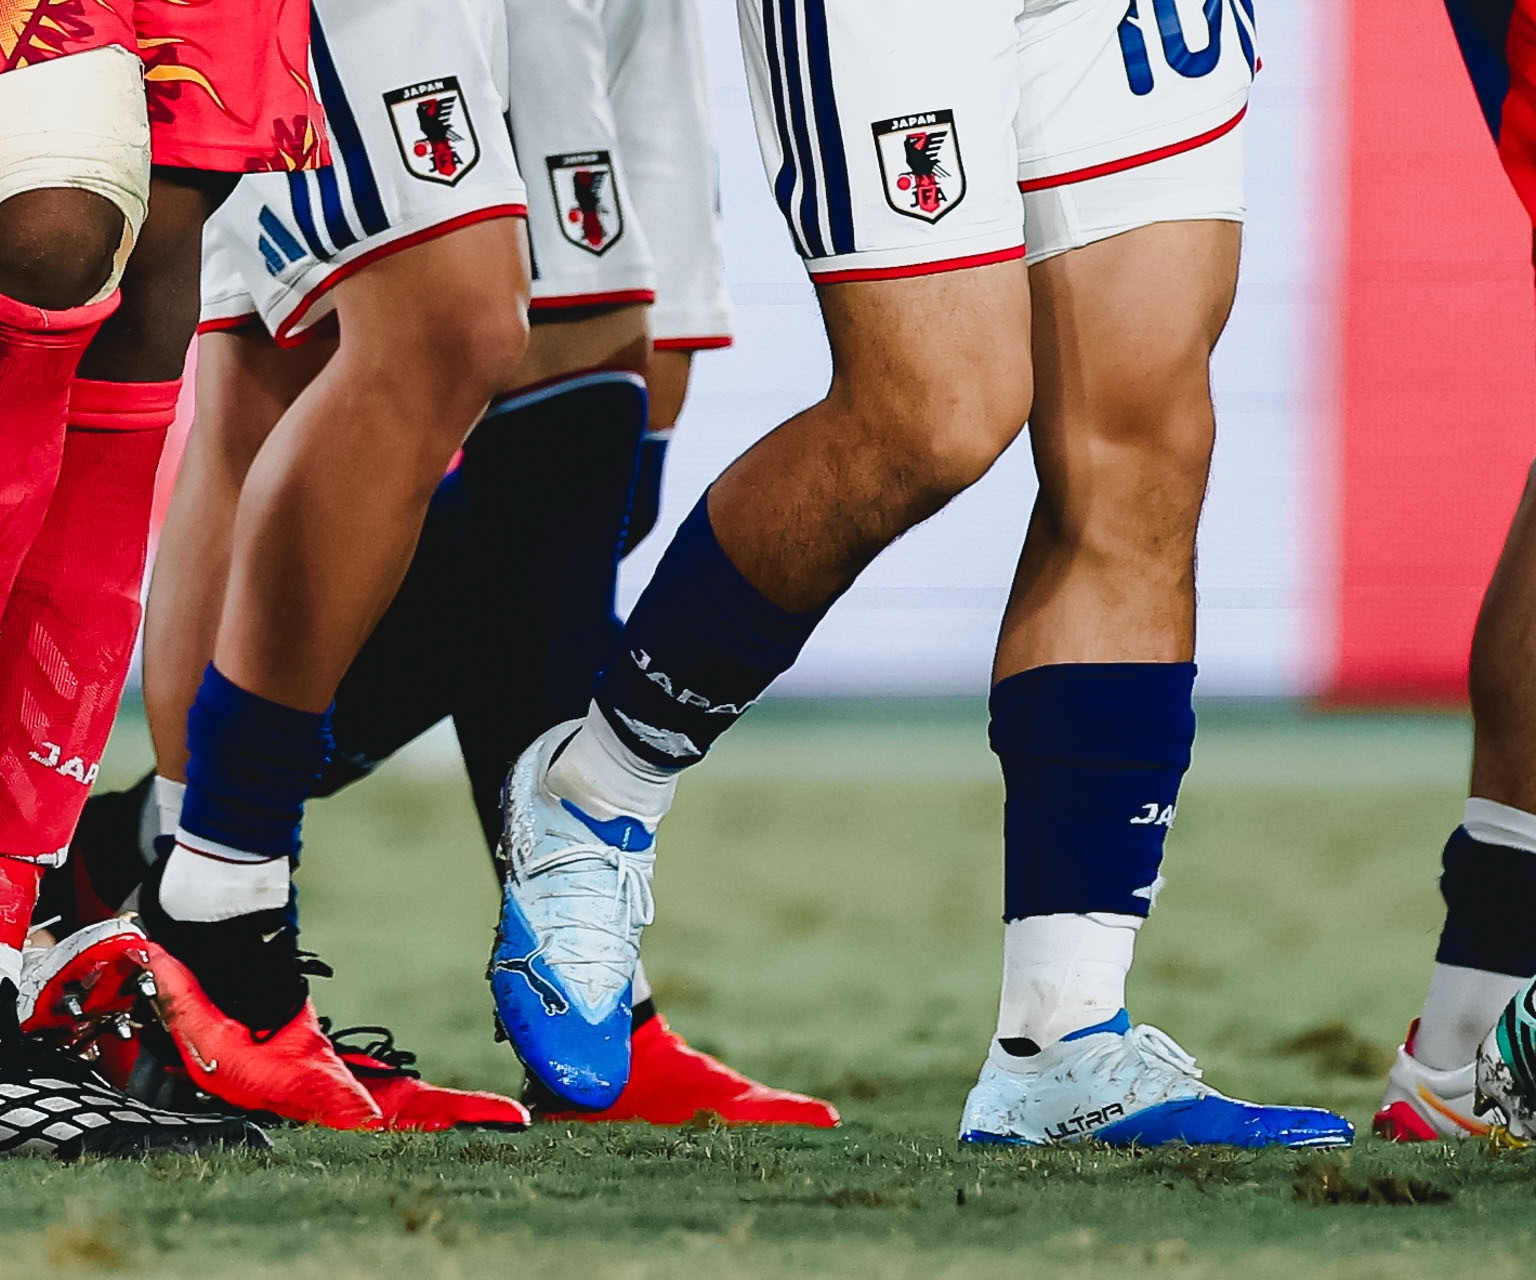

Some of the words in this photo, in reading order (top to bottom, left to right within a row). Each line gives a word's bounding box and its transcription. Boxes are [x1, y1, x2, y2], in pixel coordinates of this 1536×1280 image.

[403, 81, 444, 99] JAPAN
[892, 114, 936, 130] JAPAN
[1044, 1103, 1124, 1139] ULTRA
